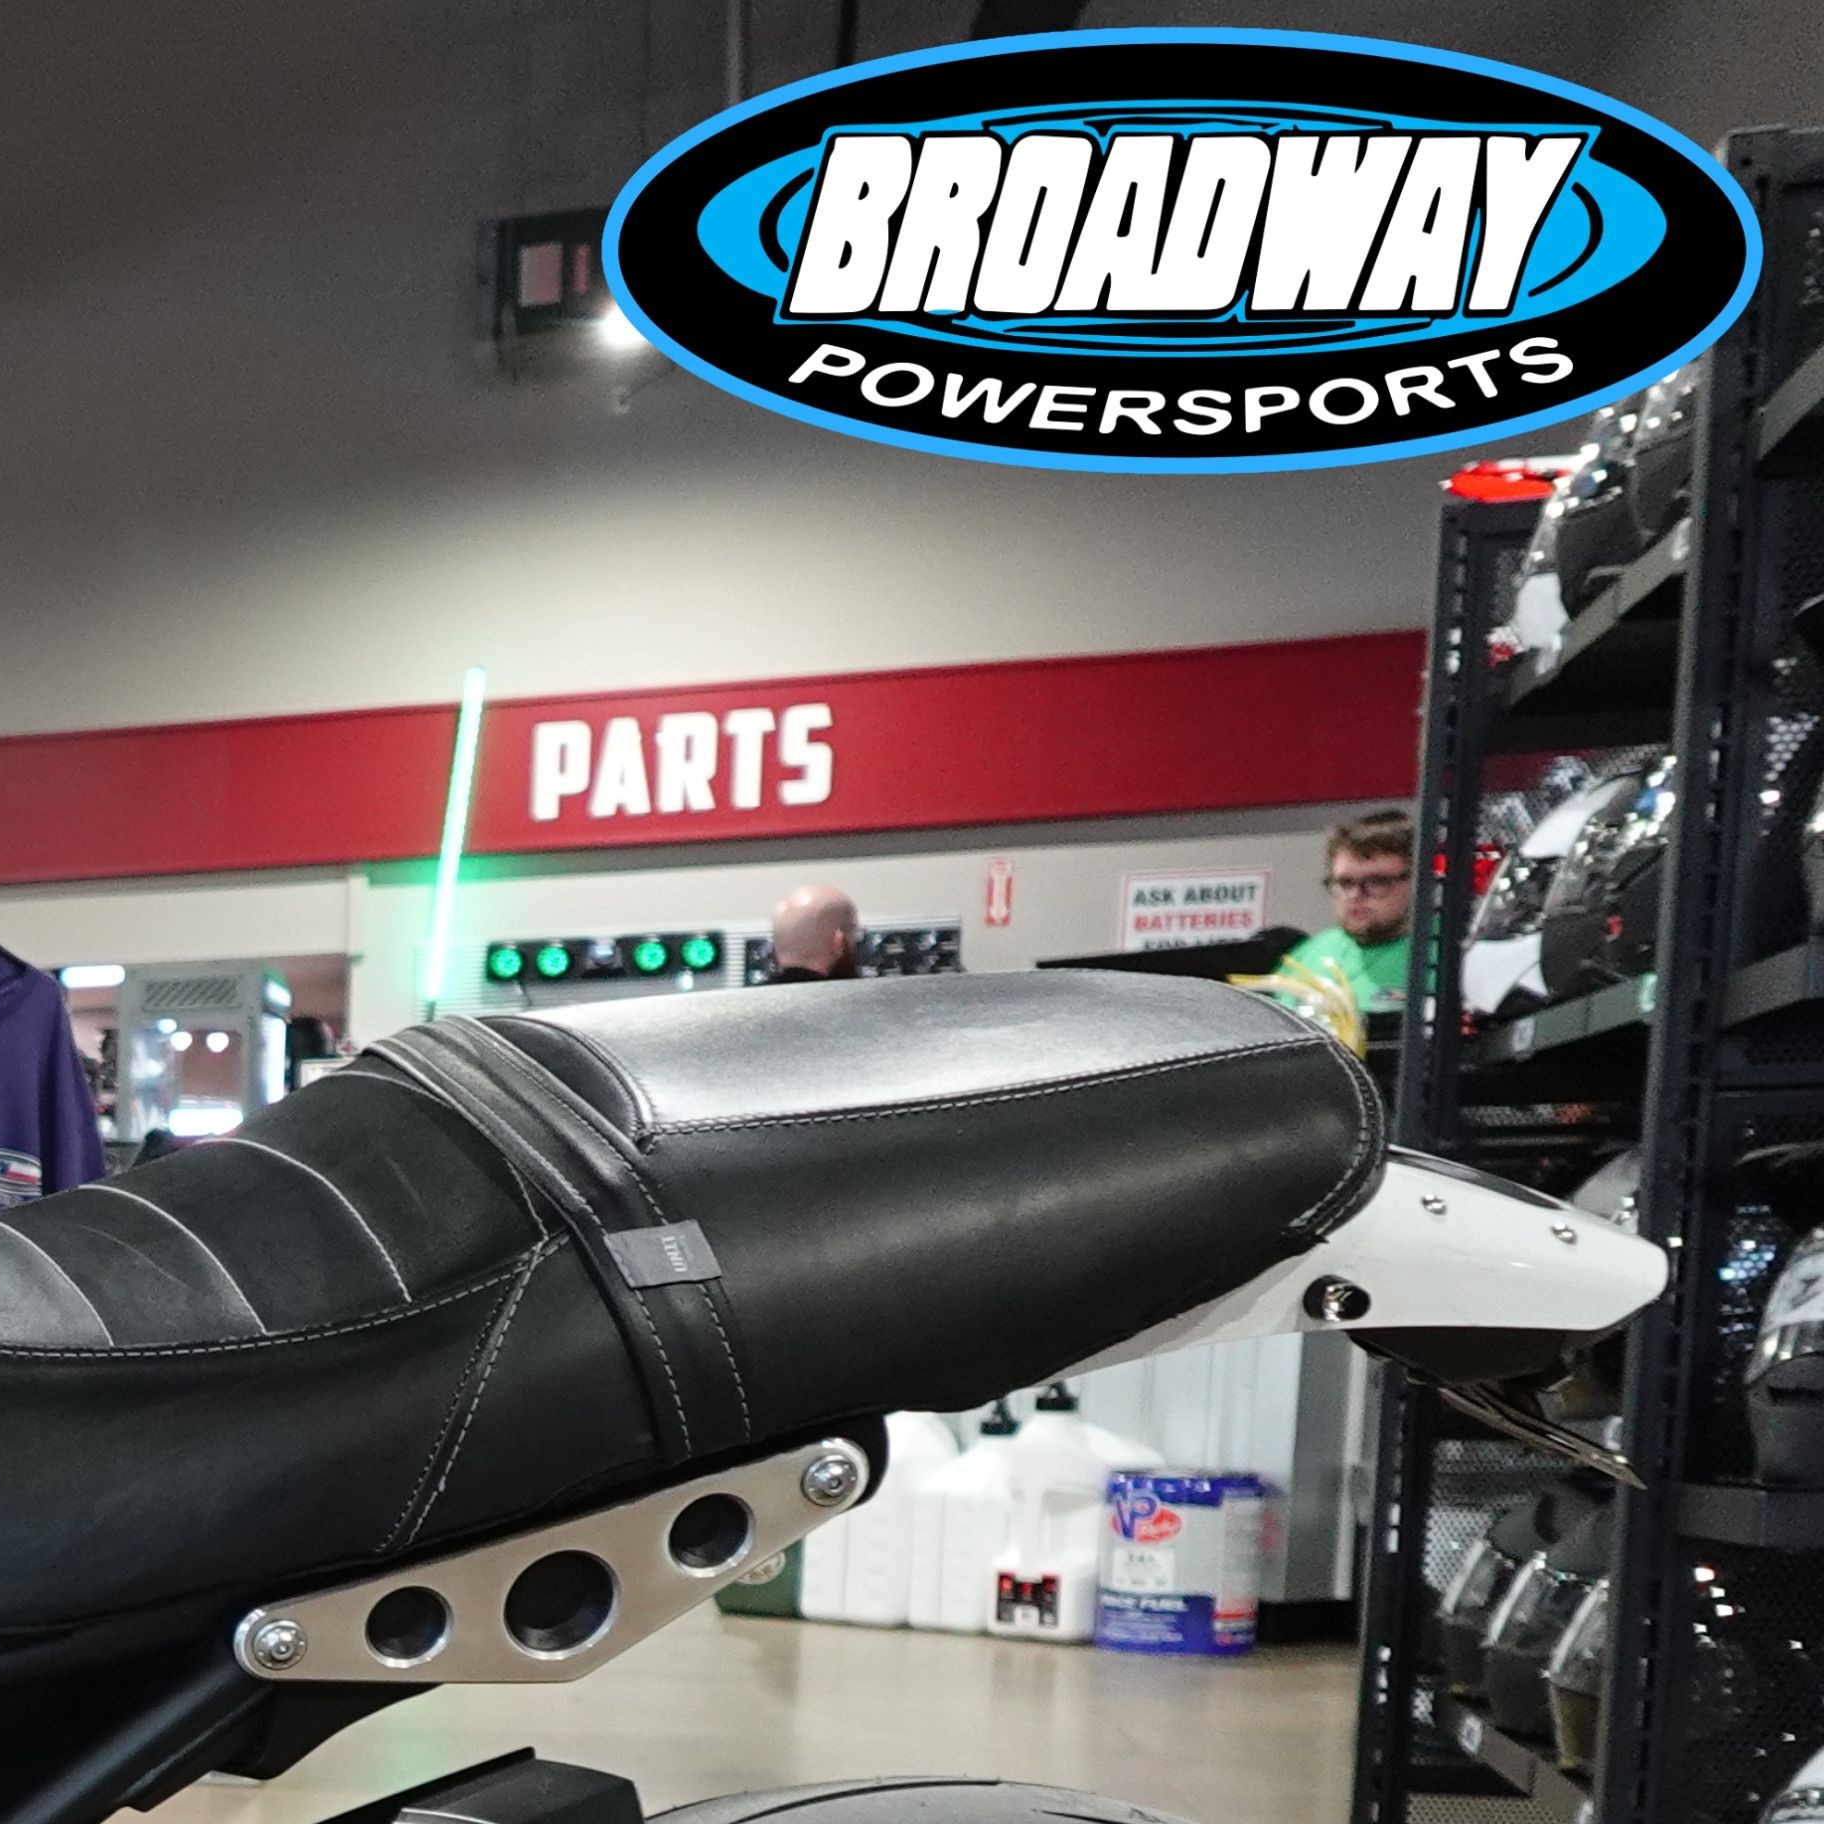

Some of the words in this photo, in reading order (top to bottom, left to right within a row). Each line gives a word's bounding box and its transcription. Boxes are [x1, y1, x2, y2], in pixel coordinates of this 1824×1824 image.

[529, 702, 833, 822] PARTS
[1133, 887, 1175, 906] ASK
[1183, 883, 1257, 905] ABOUT
[1134, 912, 1254, 931] BATTERIES
